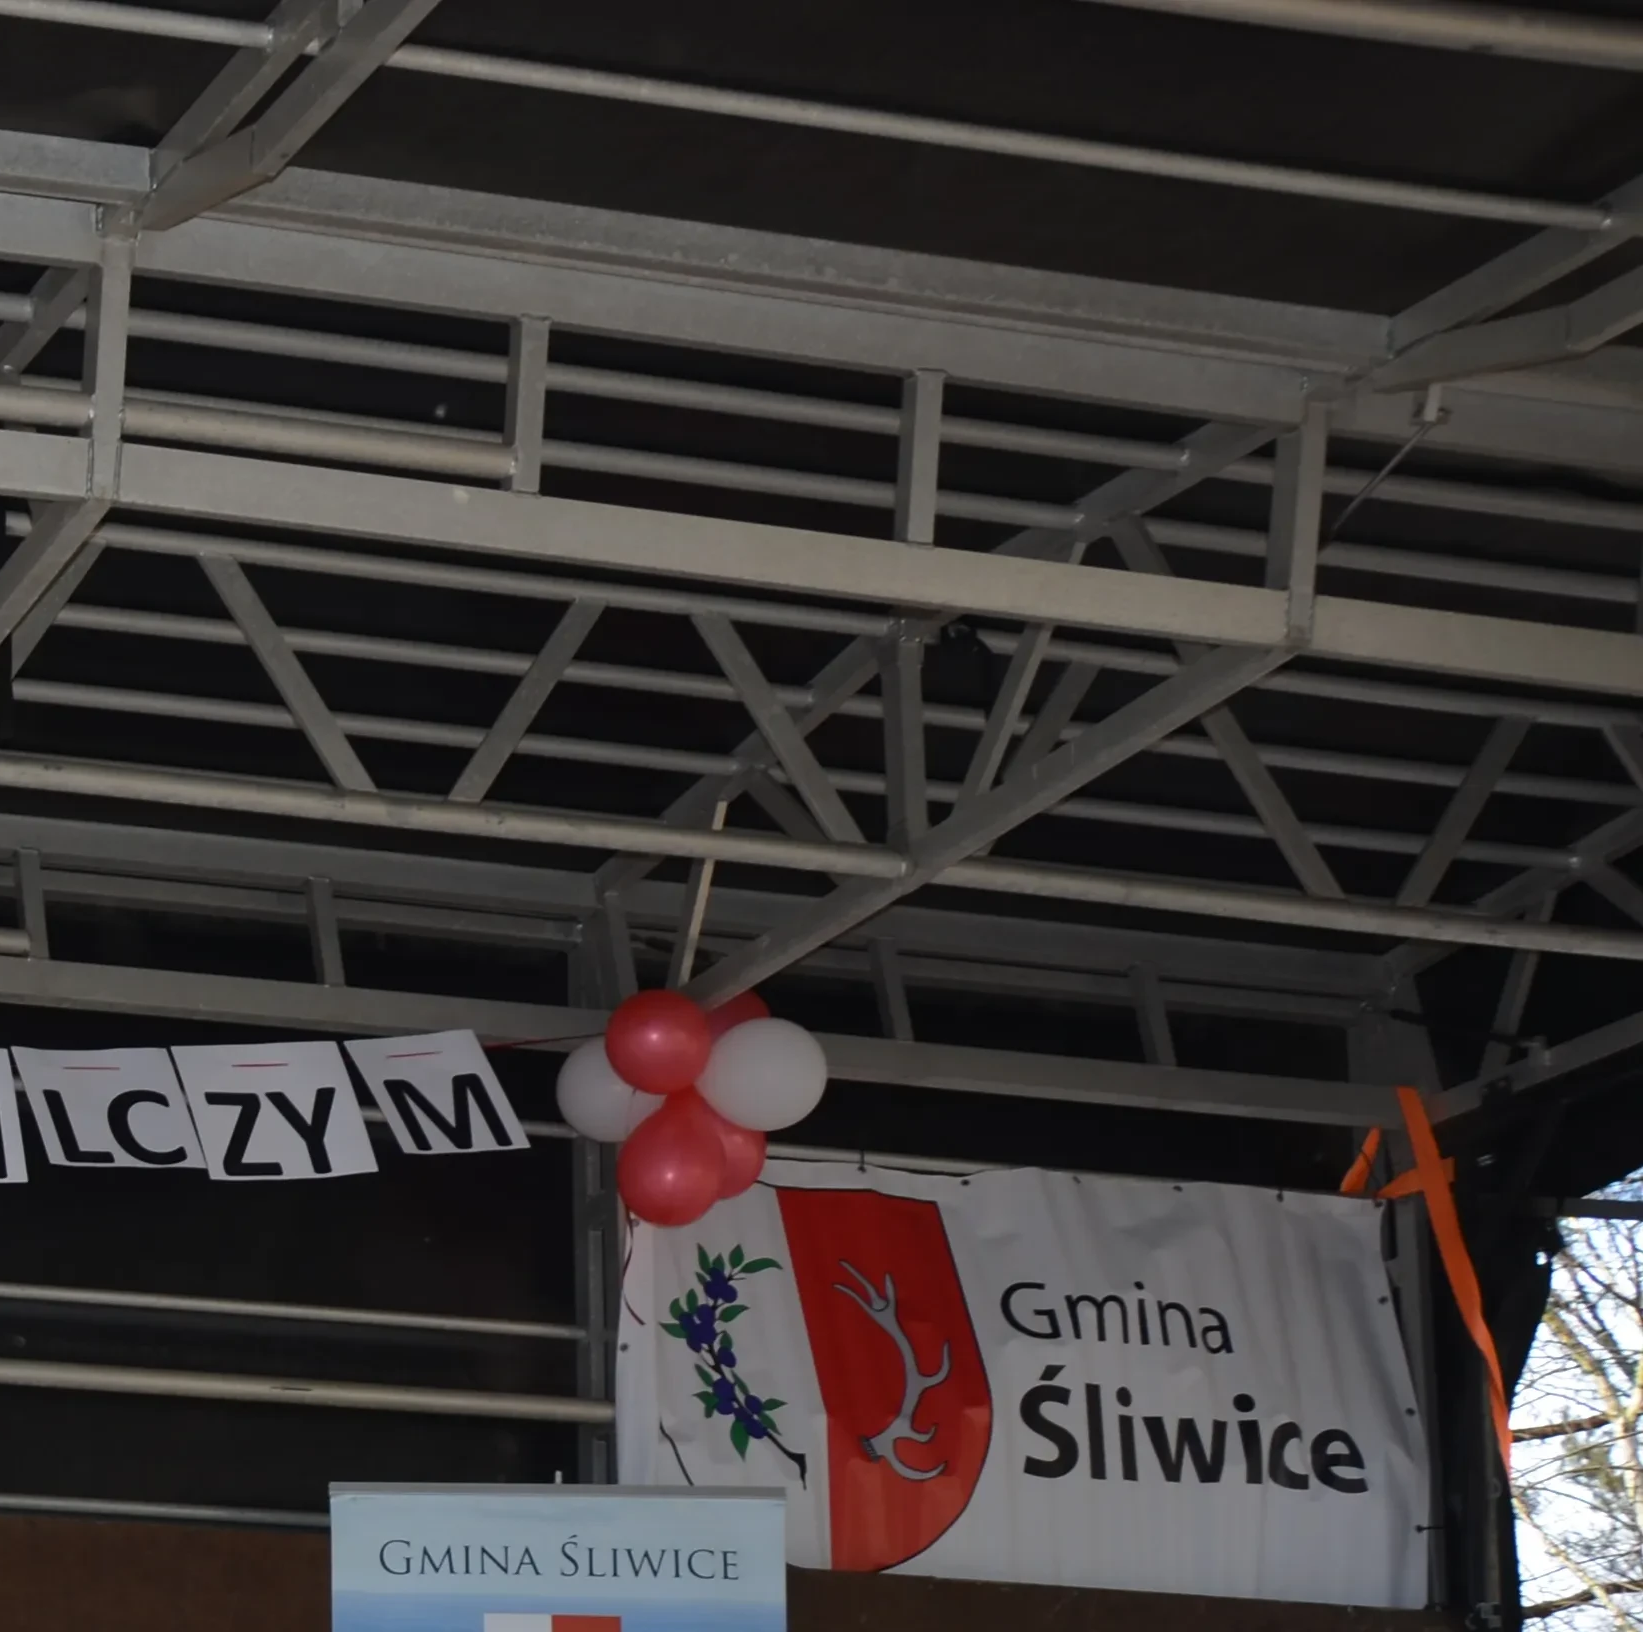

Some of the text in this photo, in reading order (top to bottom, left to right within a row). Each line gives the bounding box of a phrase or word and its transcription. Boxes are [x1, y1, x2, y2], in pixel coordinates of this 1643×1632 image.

[1000, 1281, 1235, 1354] Gmina
[1019, 1365, 1370, 1495] Śliwice
[379, 1534, 740, 1580] GMINA ŚLIWICE
